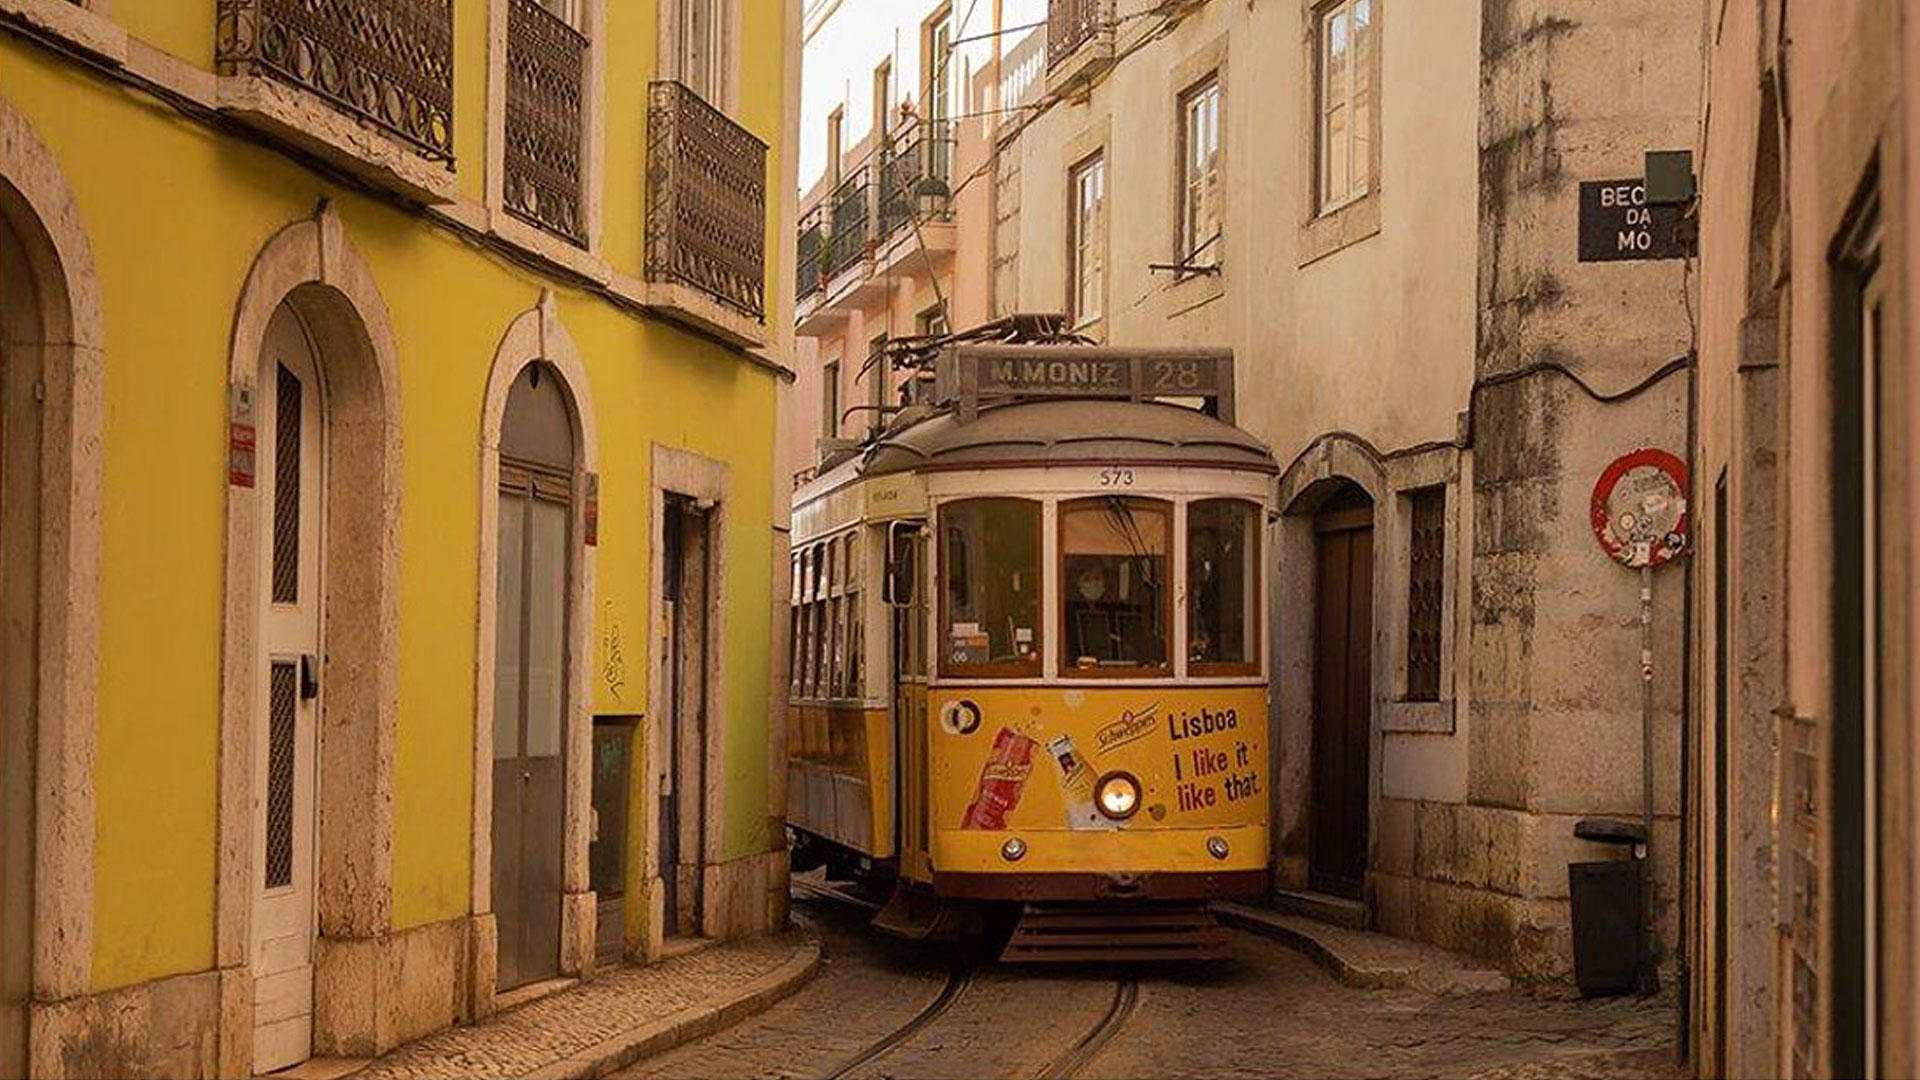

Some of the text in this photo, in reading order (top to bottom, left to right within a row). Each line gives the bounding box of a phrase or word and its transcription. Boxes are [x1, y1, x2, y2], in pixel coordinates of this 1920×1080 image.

[1601, 186, 1645, 207] BEC
[1626, 208, 1652, 225] DA
[1154, 361, 1200, 389] 28
[1100, 470, 1134, 486] 573
[1168, 707, 1237, 740] Lisboa
[1174, 741, 1249, 781] I like it
[1177, 782, 1216, 812] like
